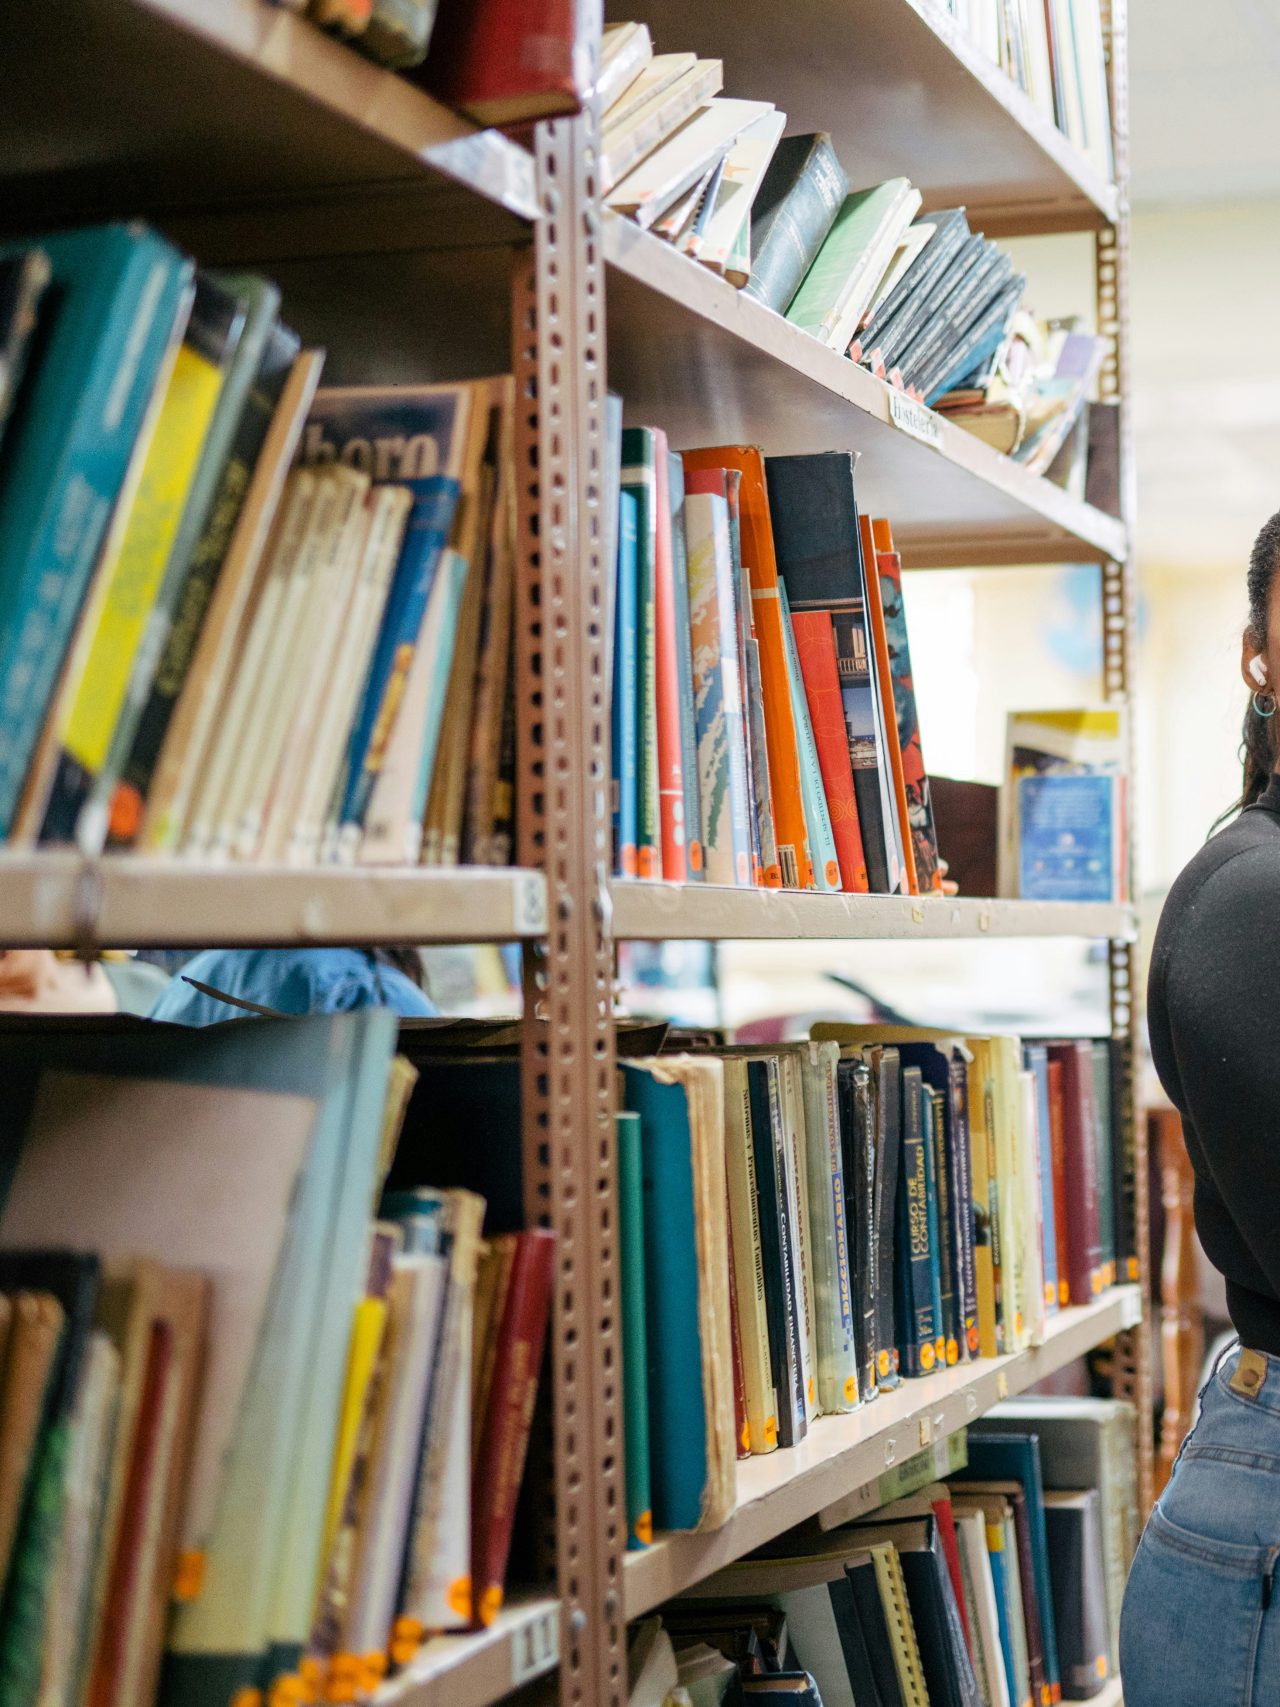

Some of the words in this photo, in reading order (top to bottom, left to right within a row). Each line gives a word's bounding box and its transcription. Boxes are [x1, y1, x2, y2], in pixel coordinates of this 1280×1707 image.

[802, 714, 813, 760] CULTURA
[816, 791, 829, 834] SENTIDO
[825, 1062, 837, 1152] CONTABILIDAD
[792, 1133, 804, 1247] CONTABILIDAD
[801, 1251, 806, 1270] DE
[908, 1177, 918, 1197] DE
[916, 1145, 929, 1253] CONTABILIDAD
[960, 1120, 968, 1198] CONTABILIDAD
[748, 1155, 760, 1242] Procedimientos
[754, 1246, 763, 1301] Contables
[834, 1177, 849, 1315] DICCIONARIO
[910, 1202, 921, 1253] CURSO
[963, 1202, 973, 1293] ADMINISTRATIVA
[781, 1213, 792, 1311] CONTABILIDAD
[789, 1315, 799, 1390] FINANCIERA
